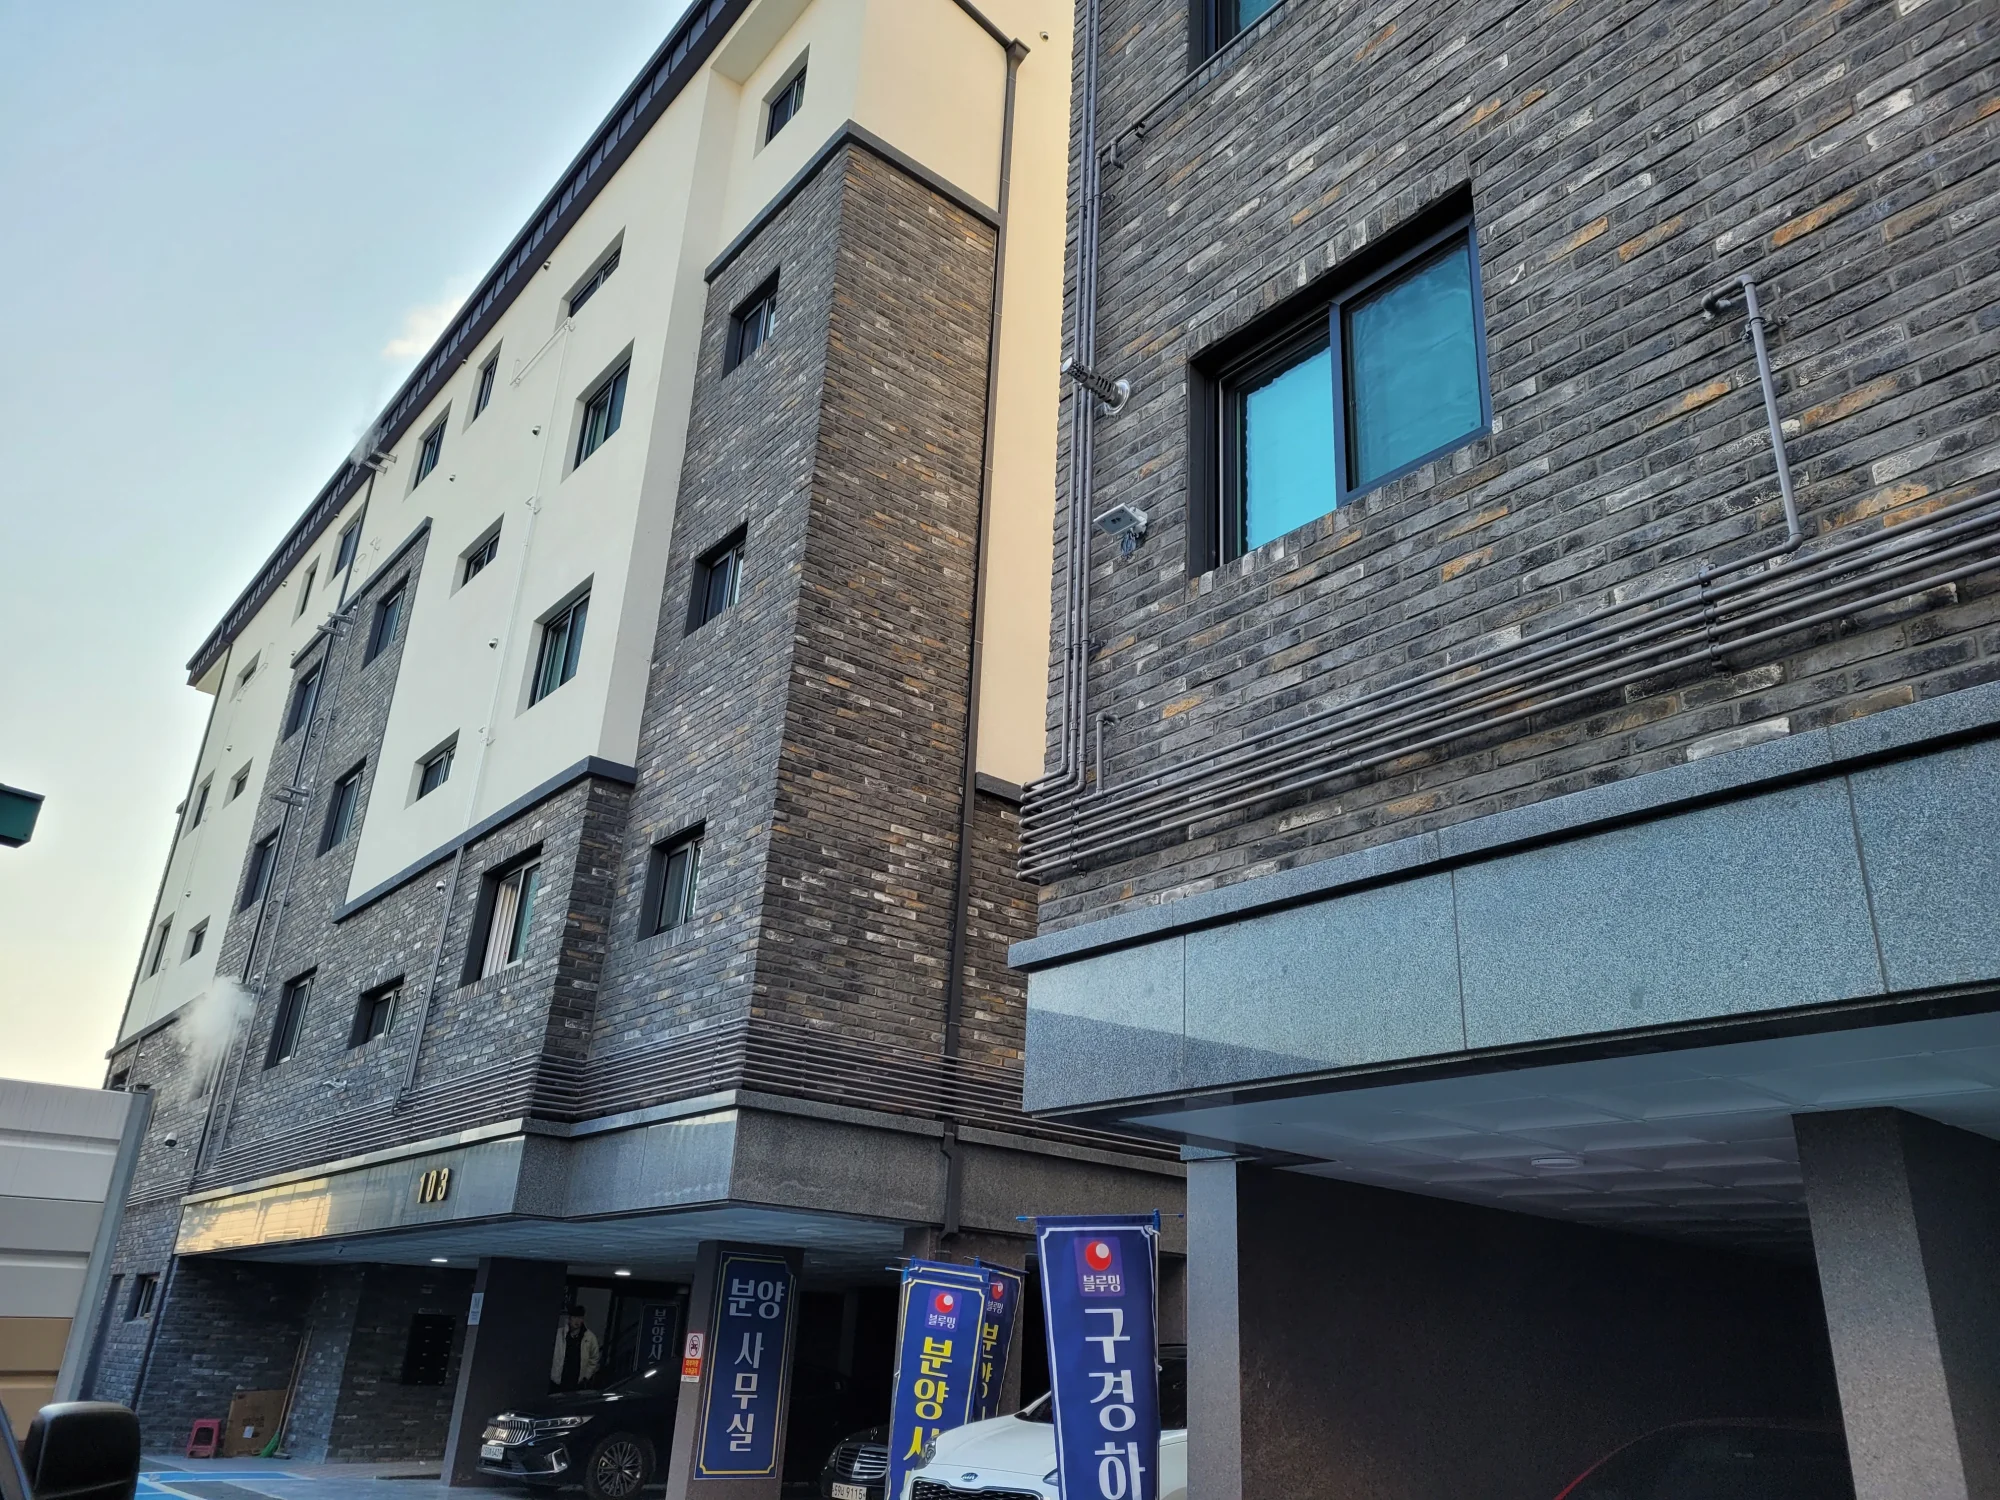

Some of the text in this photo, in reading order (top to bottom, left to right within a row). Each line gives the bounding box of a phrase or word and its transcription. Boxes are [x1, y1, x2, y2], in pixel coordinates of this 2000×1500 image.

[417, 1168, 451, 1204] 103
[1082, 1274, 1121, 1293] 블루밍
[647, 1308, 667, 1366] 분양사
[928, 1313, 957, 1330] 블루밍
[726, 1278, 786, 1452] 분양 사무실
[903, 1336, 953, 1488] 분양사
[1084, 1308, 1146, 1500] 구경하
